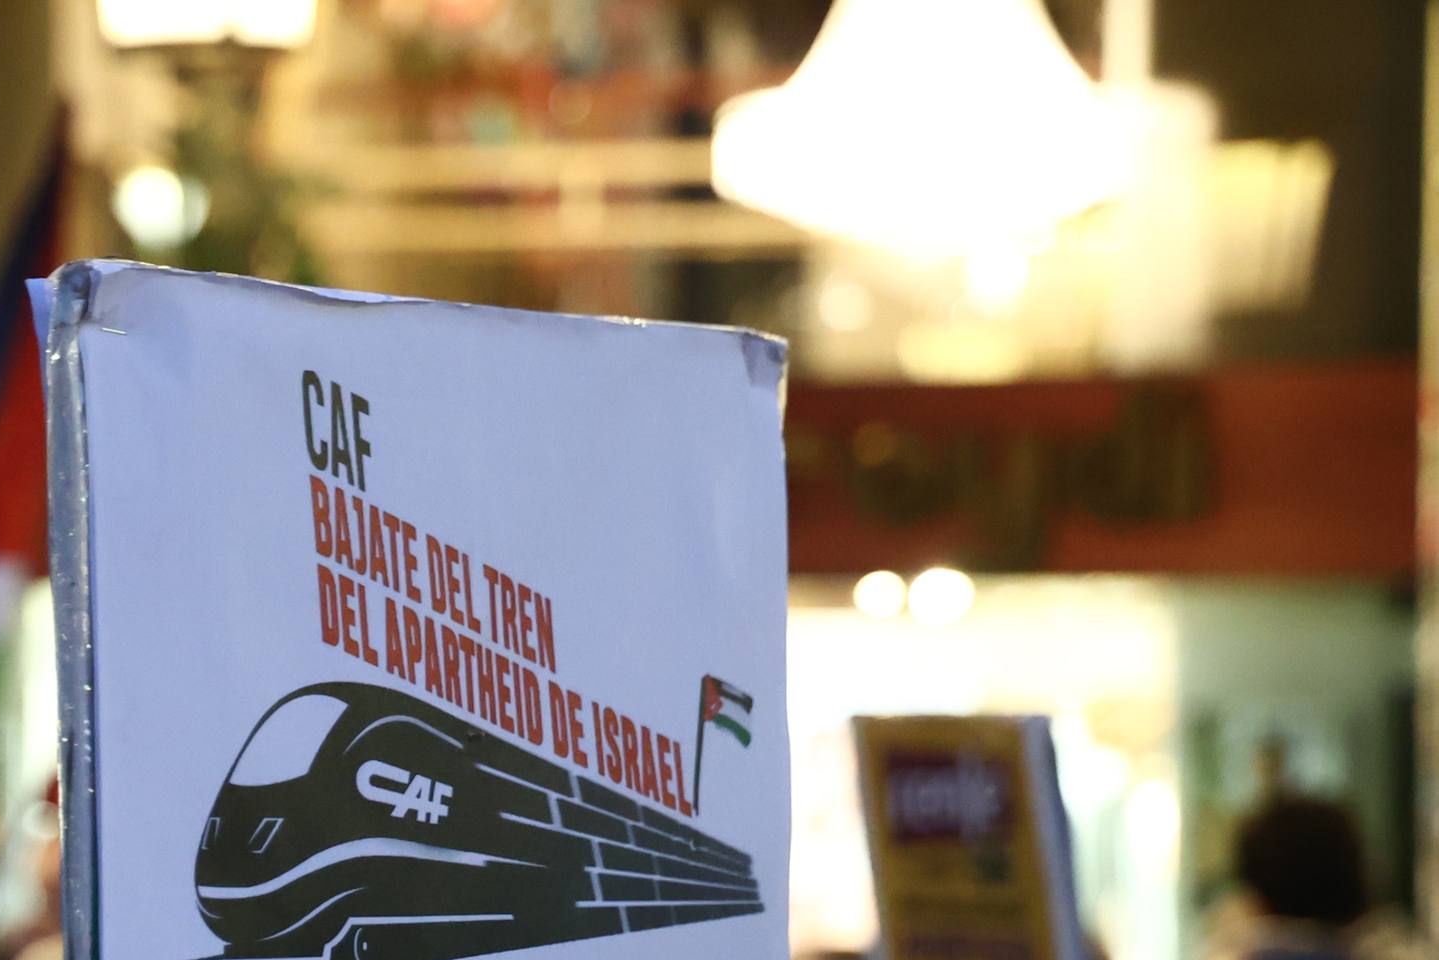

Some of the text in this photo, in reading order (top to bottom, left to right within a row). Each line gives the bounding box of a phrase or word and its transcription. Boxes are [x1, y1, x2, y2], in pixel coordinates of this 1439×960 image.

[303, 370, 371, 492] CAF
[310, 475, 557, 673] BAJATE DEL TREN
[317, 564, 692, 816] DEL APARTHEID DE ISRAEL
[356, 760, 453, 824] CAF
